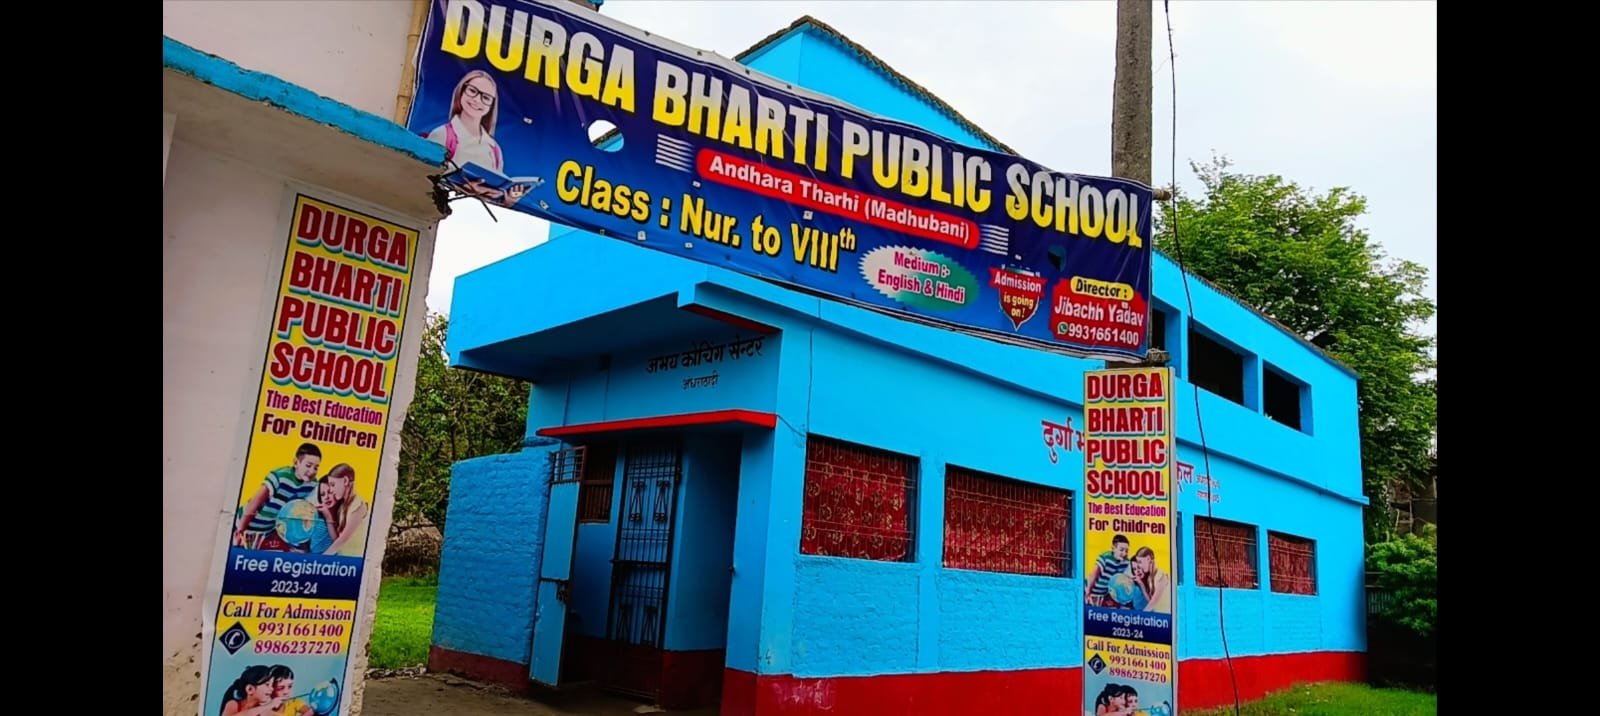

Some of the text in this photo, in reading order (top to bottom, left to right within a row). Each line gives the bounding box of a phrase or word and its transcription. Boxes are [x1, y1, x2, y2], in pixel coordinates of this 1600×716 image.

[441, 0, 1143, 248] DURGA BHARTI PUBLIC SCHOOL
[556, 160, 650, 222] Class
[680, 193, 741, 247] Nur.
[751, 214, 781, 256] to
[709, 155, 970, 245] Andhara Tharhi (Madhubani)
[296, 203, 409, 270] DURGA
[894, 251, 939, 275] Medium
[288, 251, 403, 314] BHARTI
[878, 268, 965, 303] English & Hindi
[994, 271, 1042, 293] Admission
[1075, 278, 1121, 297] Director
[1003, 292, 1034, 310] is going
[1054, 296, 1144, 327] Jibachh Yadav
[277, 296, 397, 357] PUBLIC
[1068, 323, 1139, 346] 9931661400
[270, 342, 387, 400] SCHOOL
[1086, 372, 1164, 401] DURGA
[266, 389, 383, 426] The Best Education
[261, 413, 378, 450] For Children
[1087, 406, 1164, 435] BHARTI
[1041, 416, 1074, 464] दुर्गा
[1086, 438, 1166, 466] PUBLIC
[1086, 469, 1166, 498] SCHOOL
[1088, 501, 1166, 517] The Best Education
[1088, 517, 1166, 535] For Children
[234, 554, 357, 578] Free Registration
[270, 580, 319, 595] 2023-24
[223, 600, 353, 622] Call For Admission
[1088, 608, 1169, 629] Free Registration
[258, 622, 344, 637] 9931661400
[1112, 626, 1144, 639] 2023-24
[254, 640, 341, 655] 8986237270
[1086, 639, 1170, 660] Call For Admission
[1109, 655, 1167, 671] 9931661400
[1109, 667, 1167, 684] 8986237270
